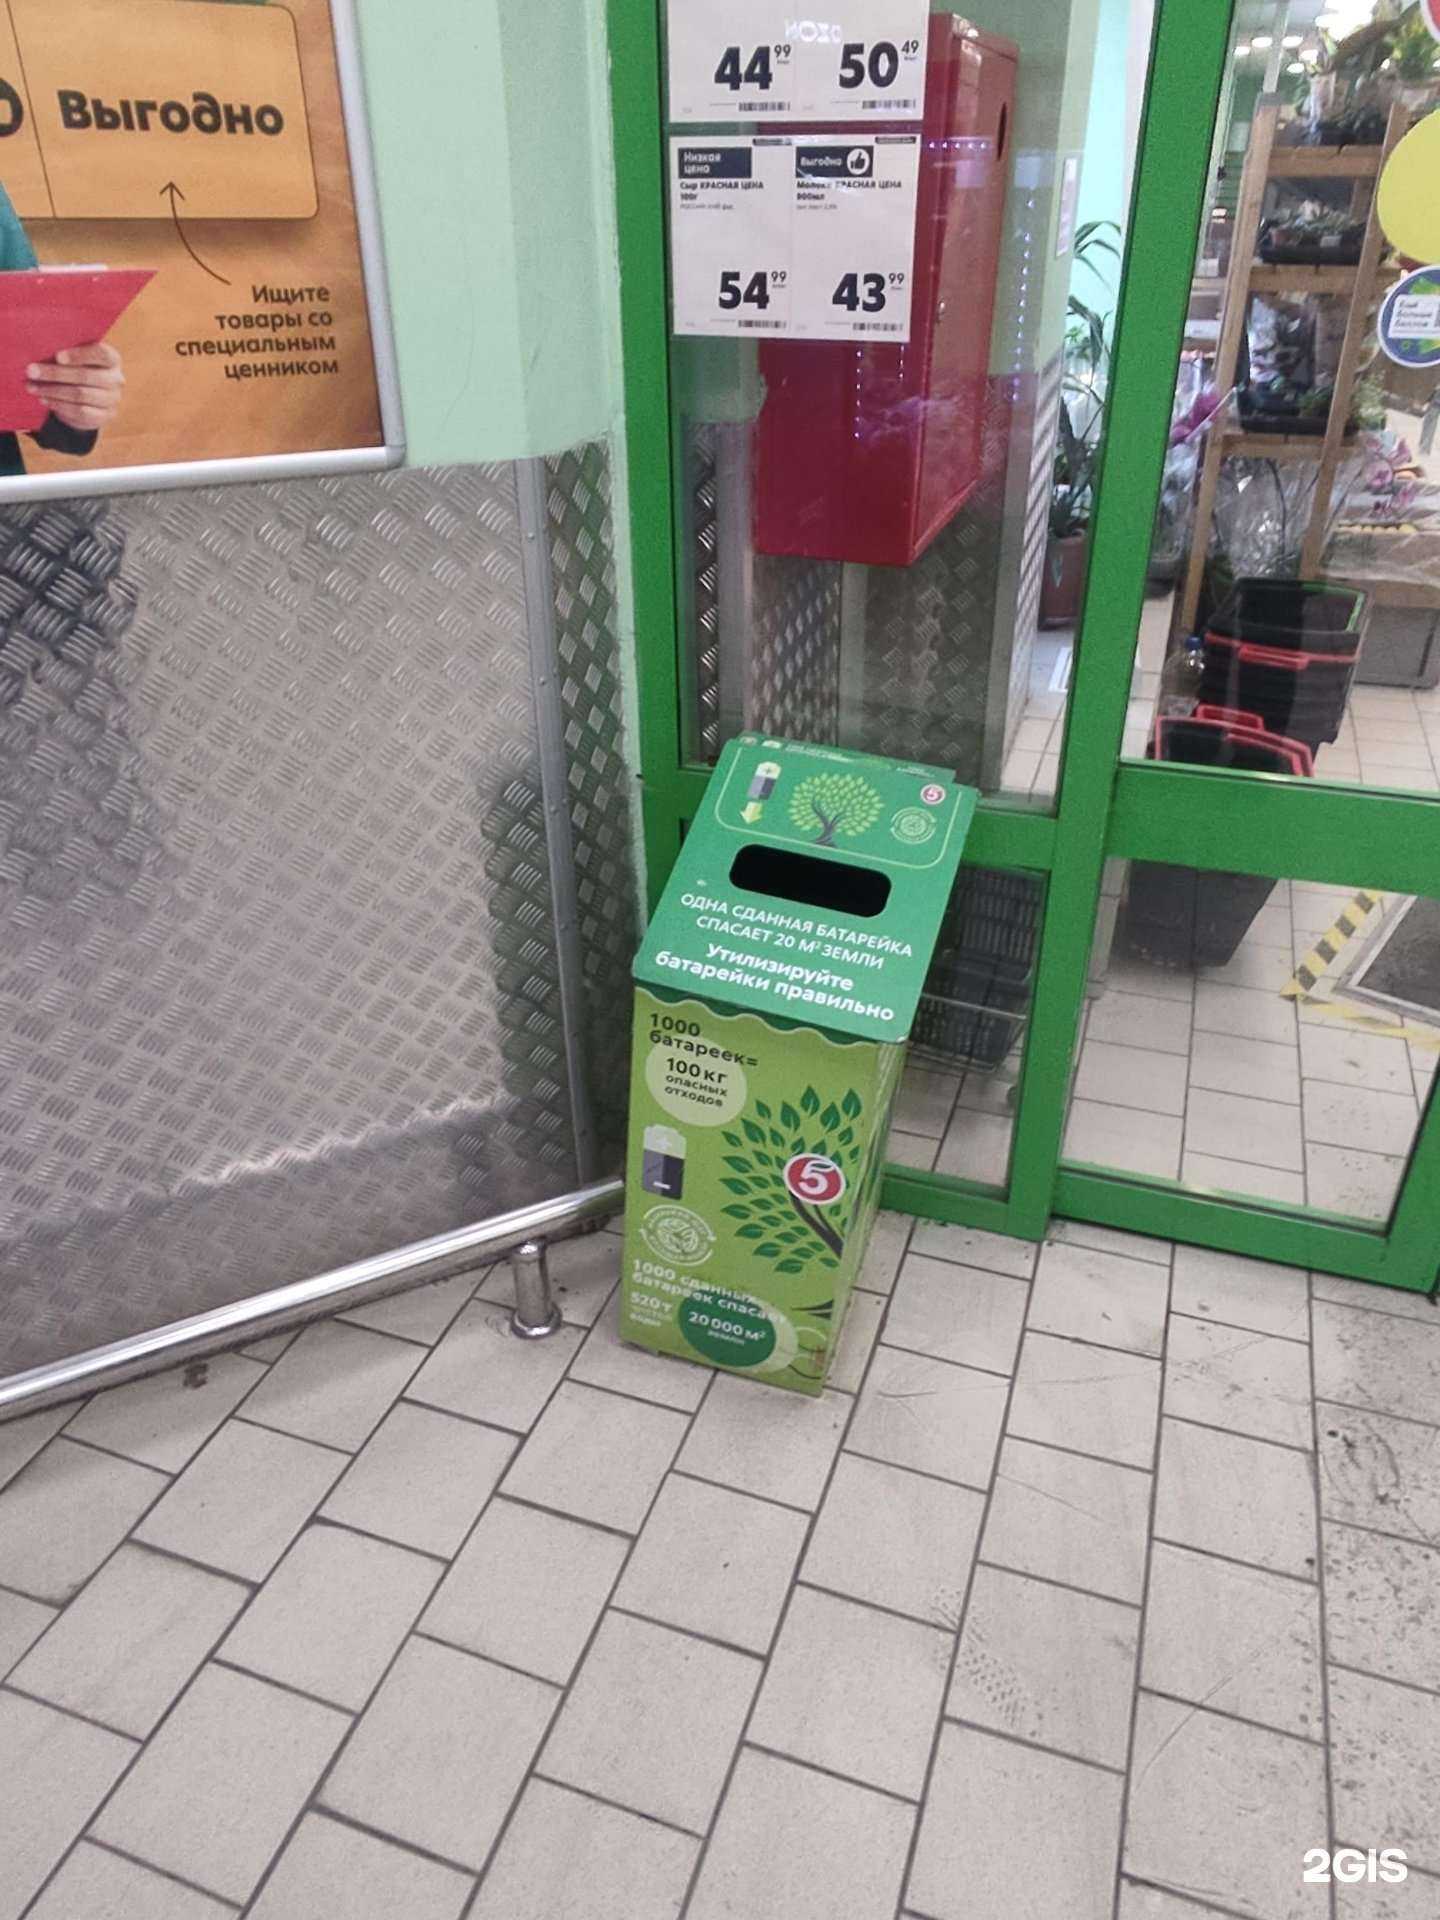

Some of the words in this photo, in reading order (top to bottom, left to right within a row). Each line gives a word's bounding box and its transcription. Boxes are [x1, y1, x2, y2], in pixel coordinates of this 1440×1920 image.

[714, 46, 773, 90] 44
[774, 44, 791, 58] 99
[839, 41, 899, 89] 50
[901, 39, 919, 54] 49
[57, 89, 284, 136] Выгодно
[741, 181, 764, 191] ЦЕНА
[252, 285, 331, 305] Ищите
[719, 271, 770, 309] 54
[771, 271, 787, 283] 99
[832, 273, 886, 312] 43
[889, 273, 905, 285] 99
[215, 312, 302, 332] товары
[308, 311, 333, 326] со
[175, 336, 336, 357] специальным
[224, 360, 338, 380] ценником
[681, 893, 728, 914] ОДНА
[732, 904, 813, 934] СДАННАЯ
[816, 924, 912, 957] БАТАРЕЙКА
[696, 915, 772, 943] СПАСАЕТ
[774, 934, 795, 948] 20
[821, 946, 885, 970] ЗЕМЛИ
[706, 943, 854, 991] Утилизируйте
[655, 950, 771, 991] батарейки
[774, 981, 895, 1021] правильно
[650, 1013, 701, 1037] 1000
[664, 1086, 723, 1107] отходов
[666, 1075, 727, 1097] опасных
[633, 1259, 676, 1280] 1000
[632, 1271, 713, 1305] батареек
